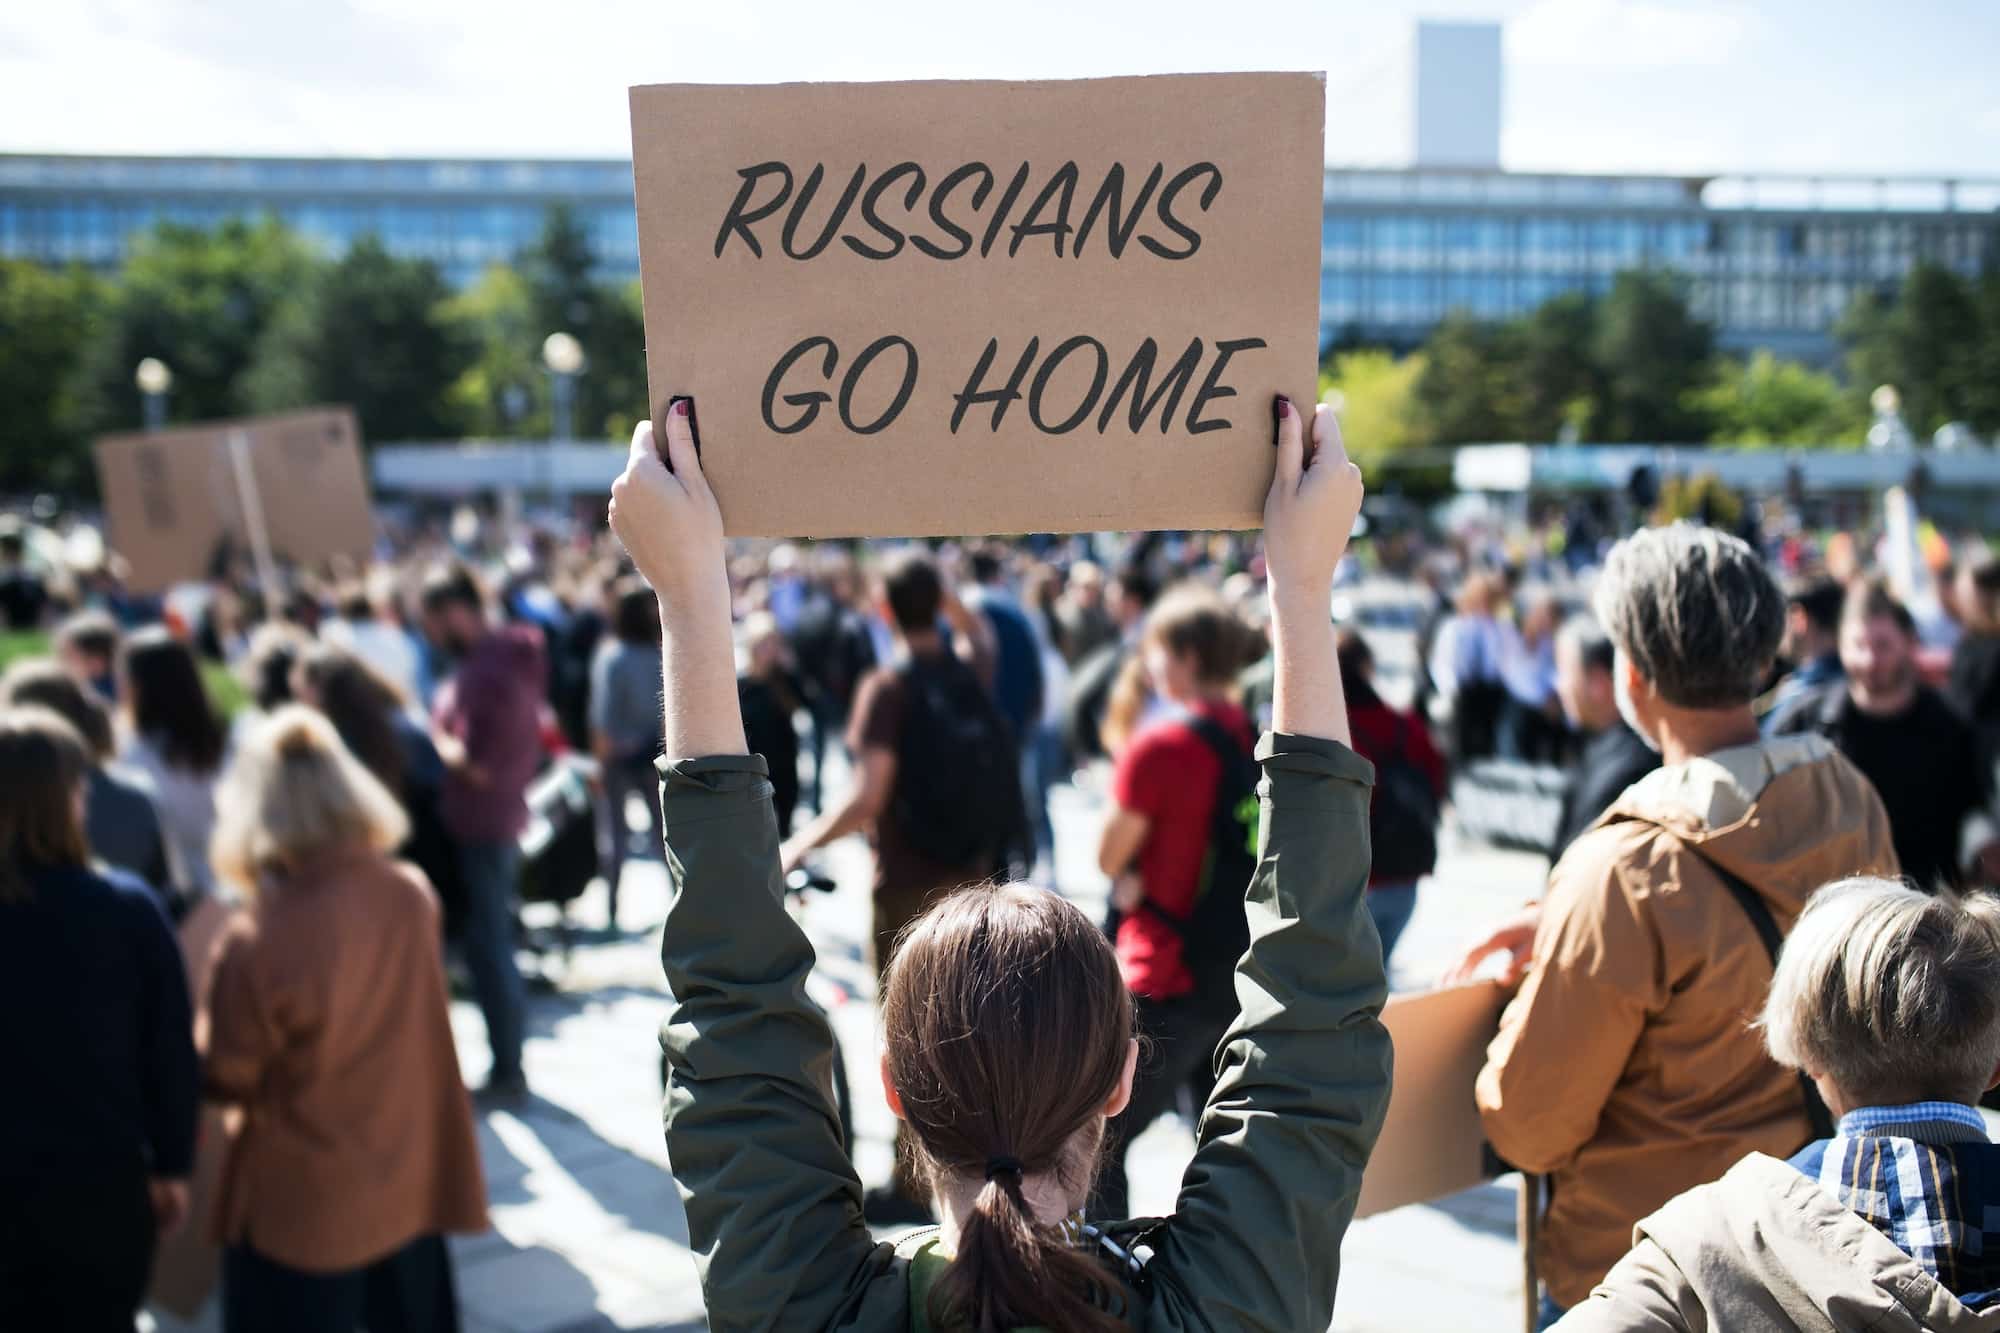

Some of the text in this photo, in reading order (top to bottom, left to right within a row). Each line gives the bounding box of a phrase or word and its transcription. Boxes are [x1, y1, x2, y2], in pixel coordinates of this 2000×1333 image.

[714, 161, 1223, 261] RUSSIANS
[760, 335, 1268, 435] GO HOME
